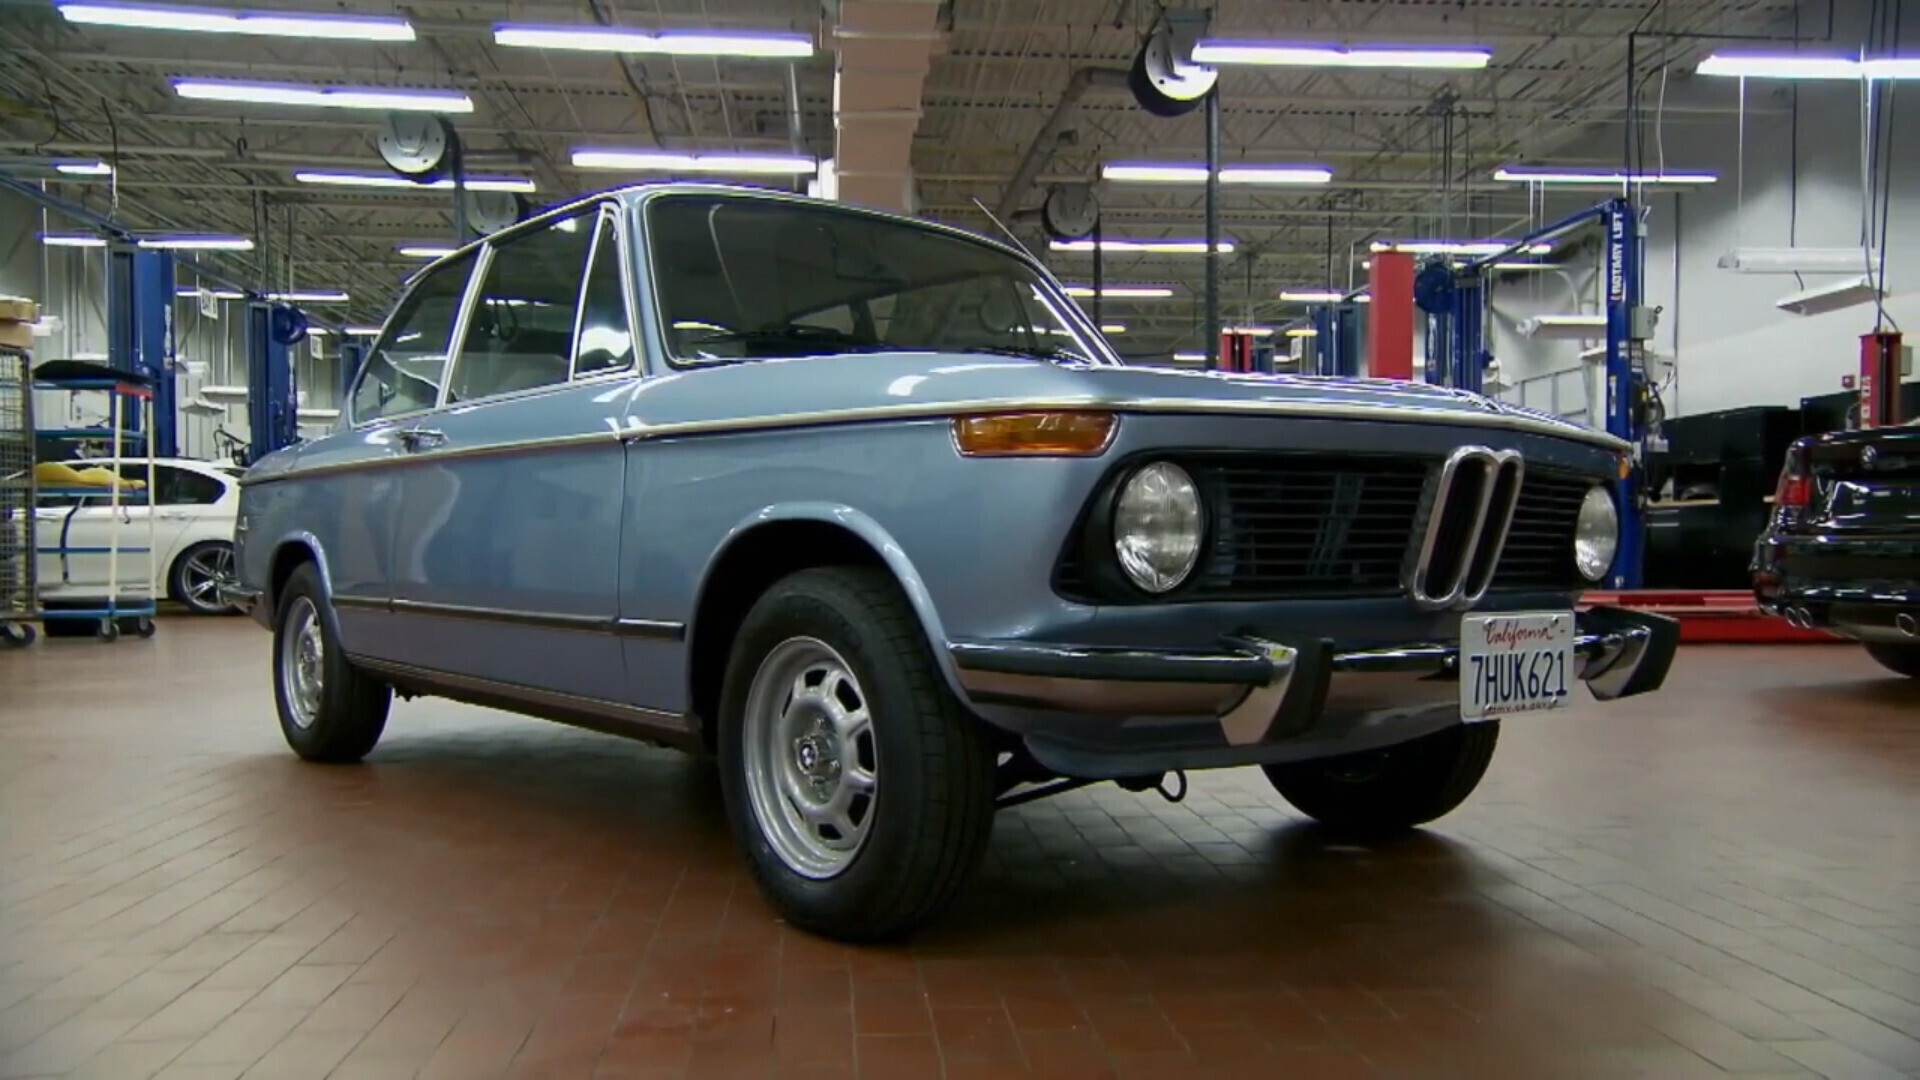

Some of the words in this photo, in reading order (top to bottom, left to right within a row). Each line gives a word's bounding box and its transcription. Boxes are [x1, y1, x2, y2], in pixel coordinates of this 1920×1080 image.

[1612, 212, 1623, 239] LIFT
[1612, 242, 1623, 294] ROTARY
[1484, 621, 1553, 650] California
[1471, 650, 1567, 705] 7HUK621
